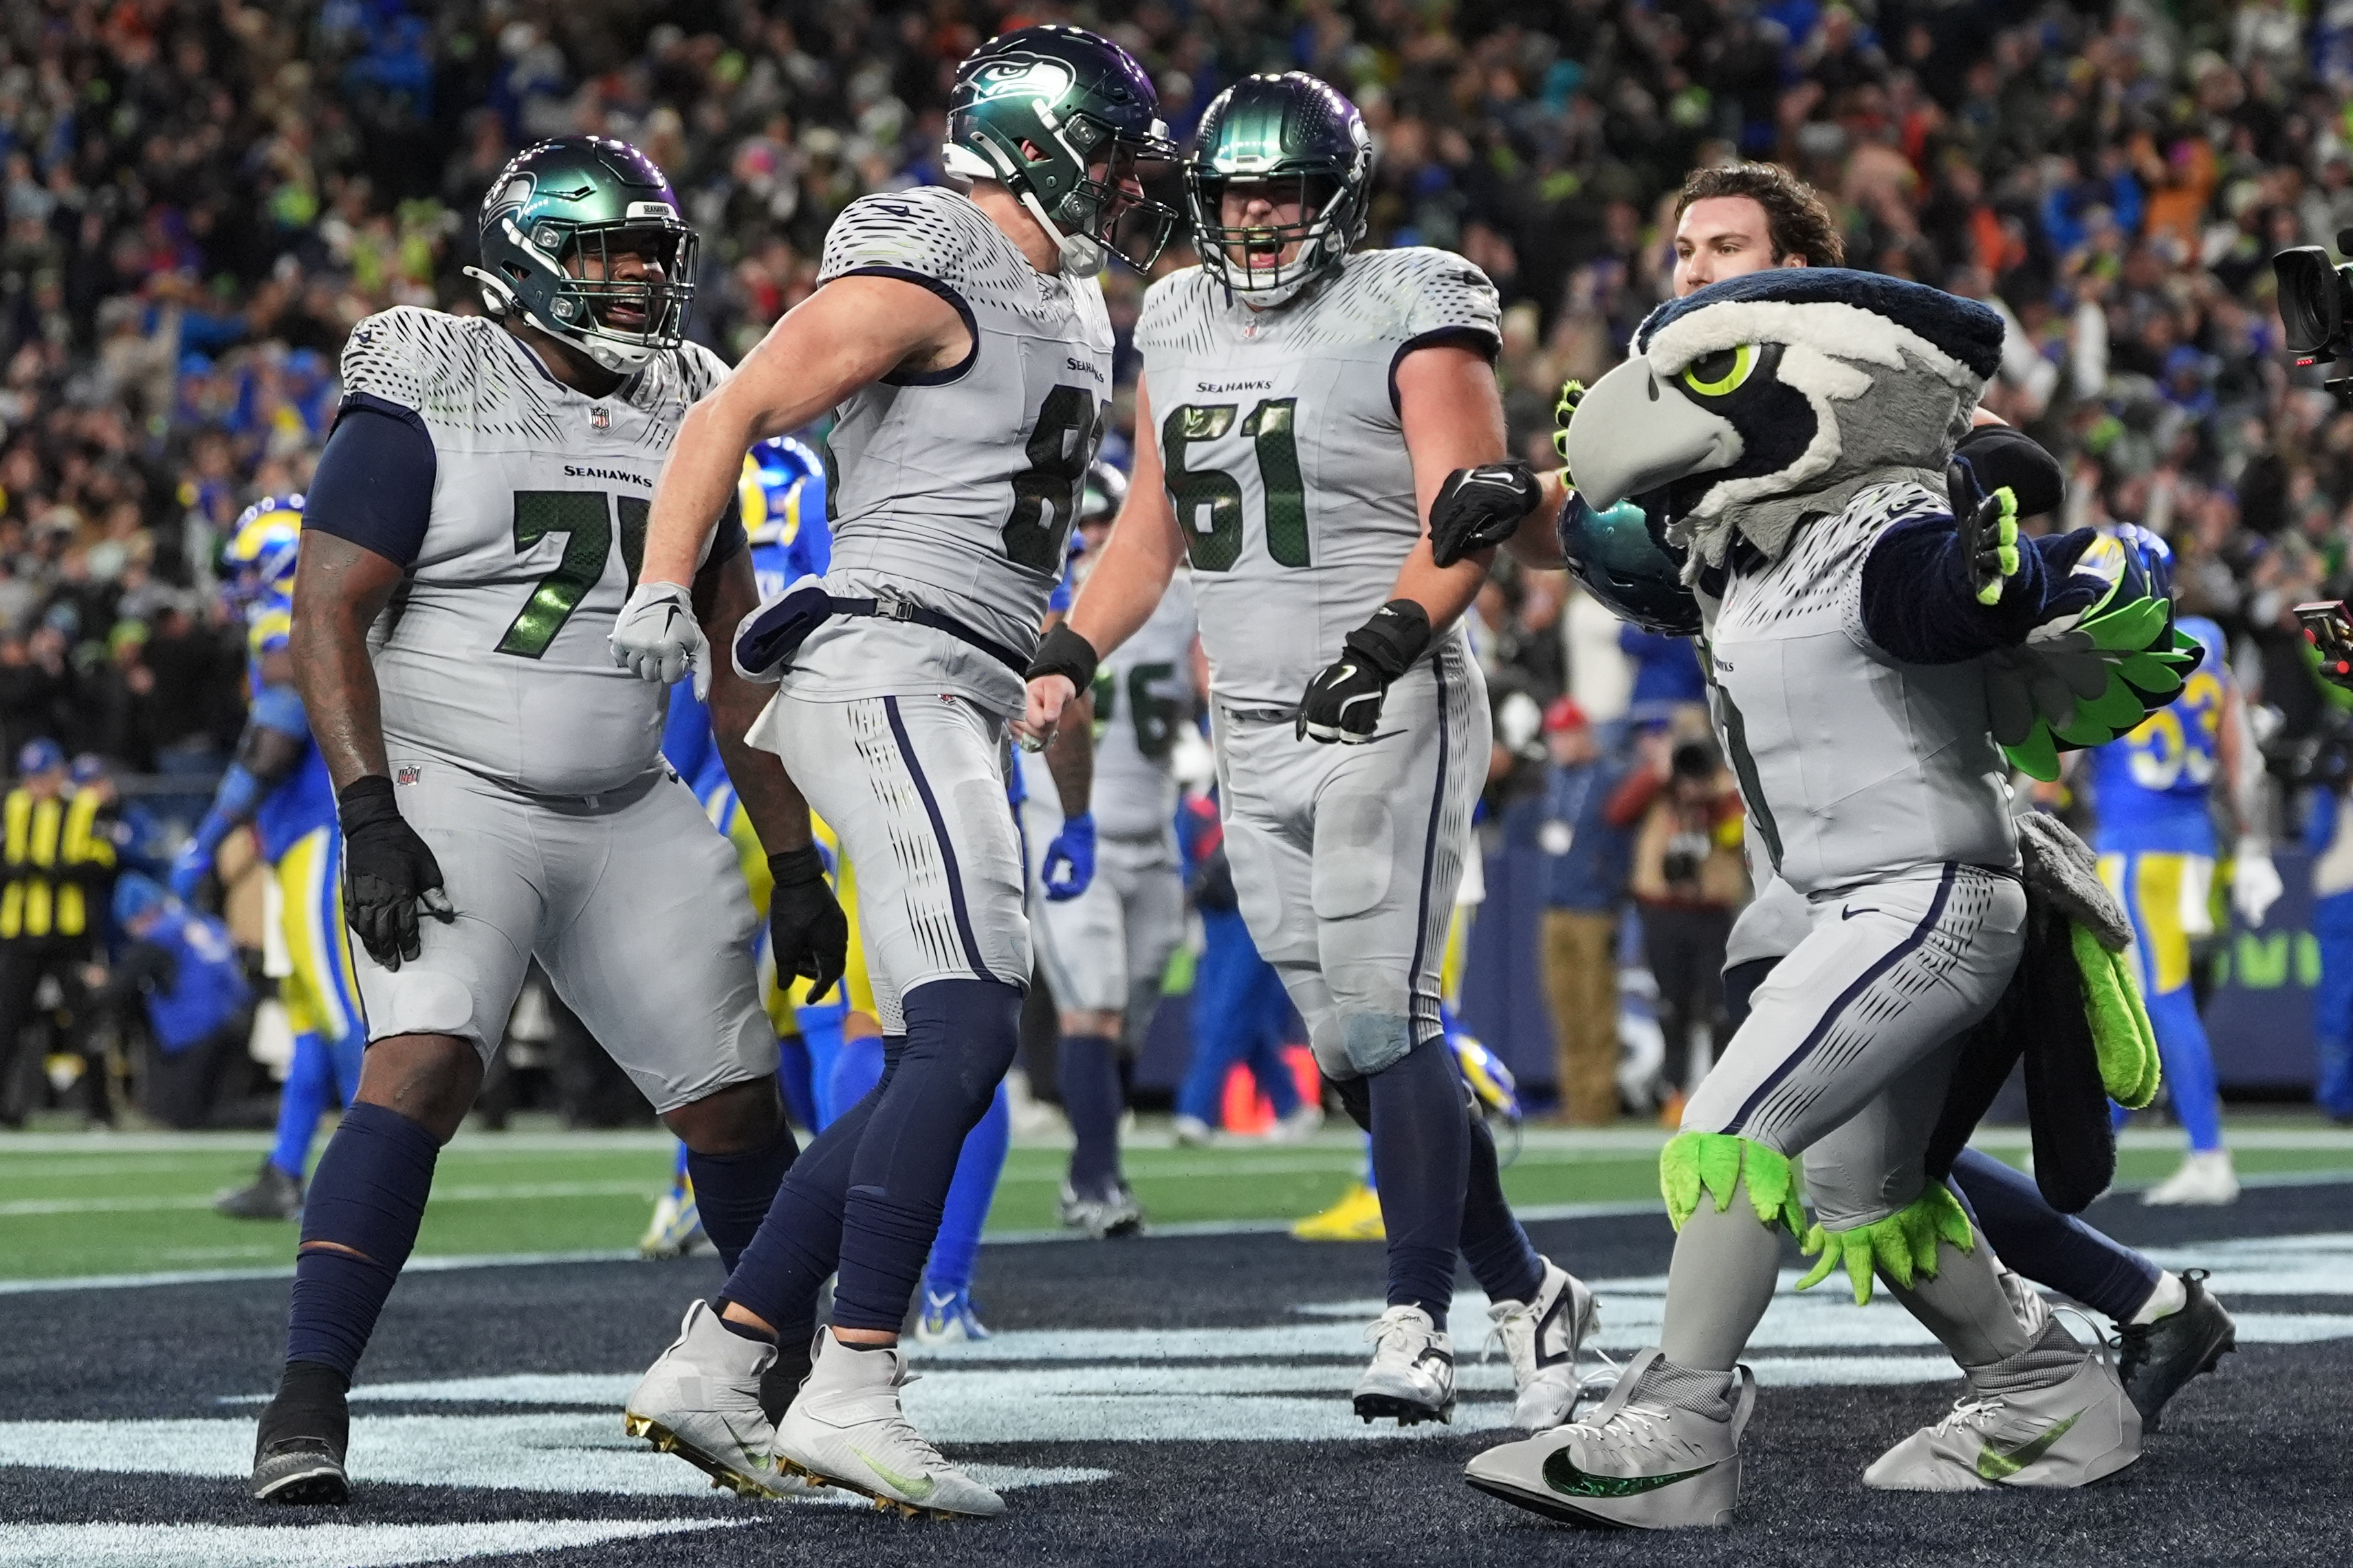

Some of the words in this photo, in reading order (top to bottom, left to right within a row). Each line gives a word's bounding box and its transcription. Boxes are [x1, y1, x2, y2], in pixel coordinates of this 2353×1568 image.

[1066, 357, 1104, 383] SEAHAKS
[1196, 381, 1273, 394] SEAHAWKS
[564, 465, 653, 487] SEAHAWKS
[1002, 384, 1113, 575] 8
[1162, 397, 1311, 572] 61
